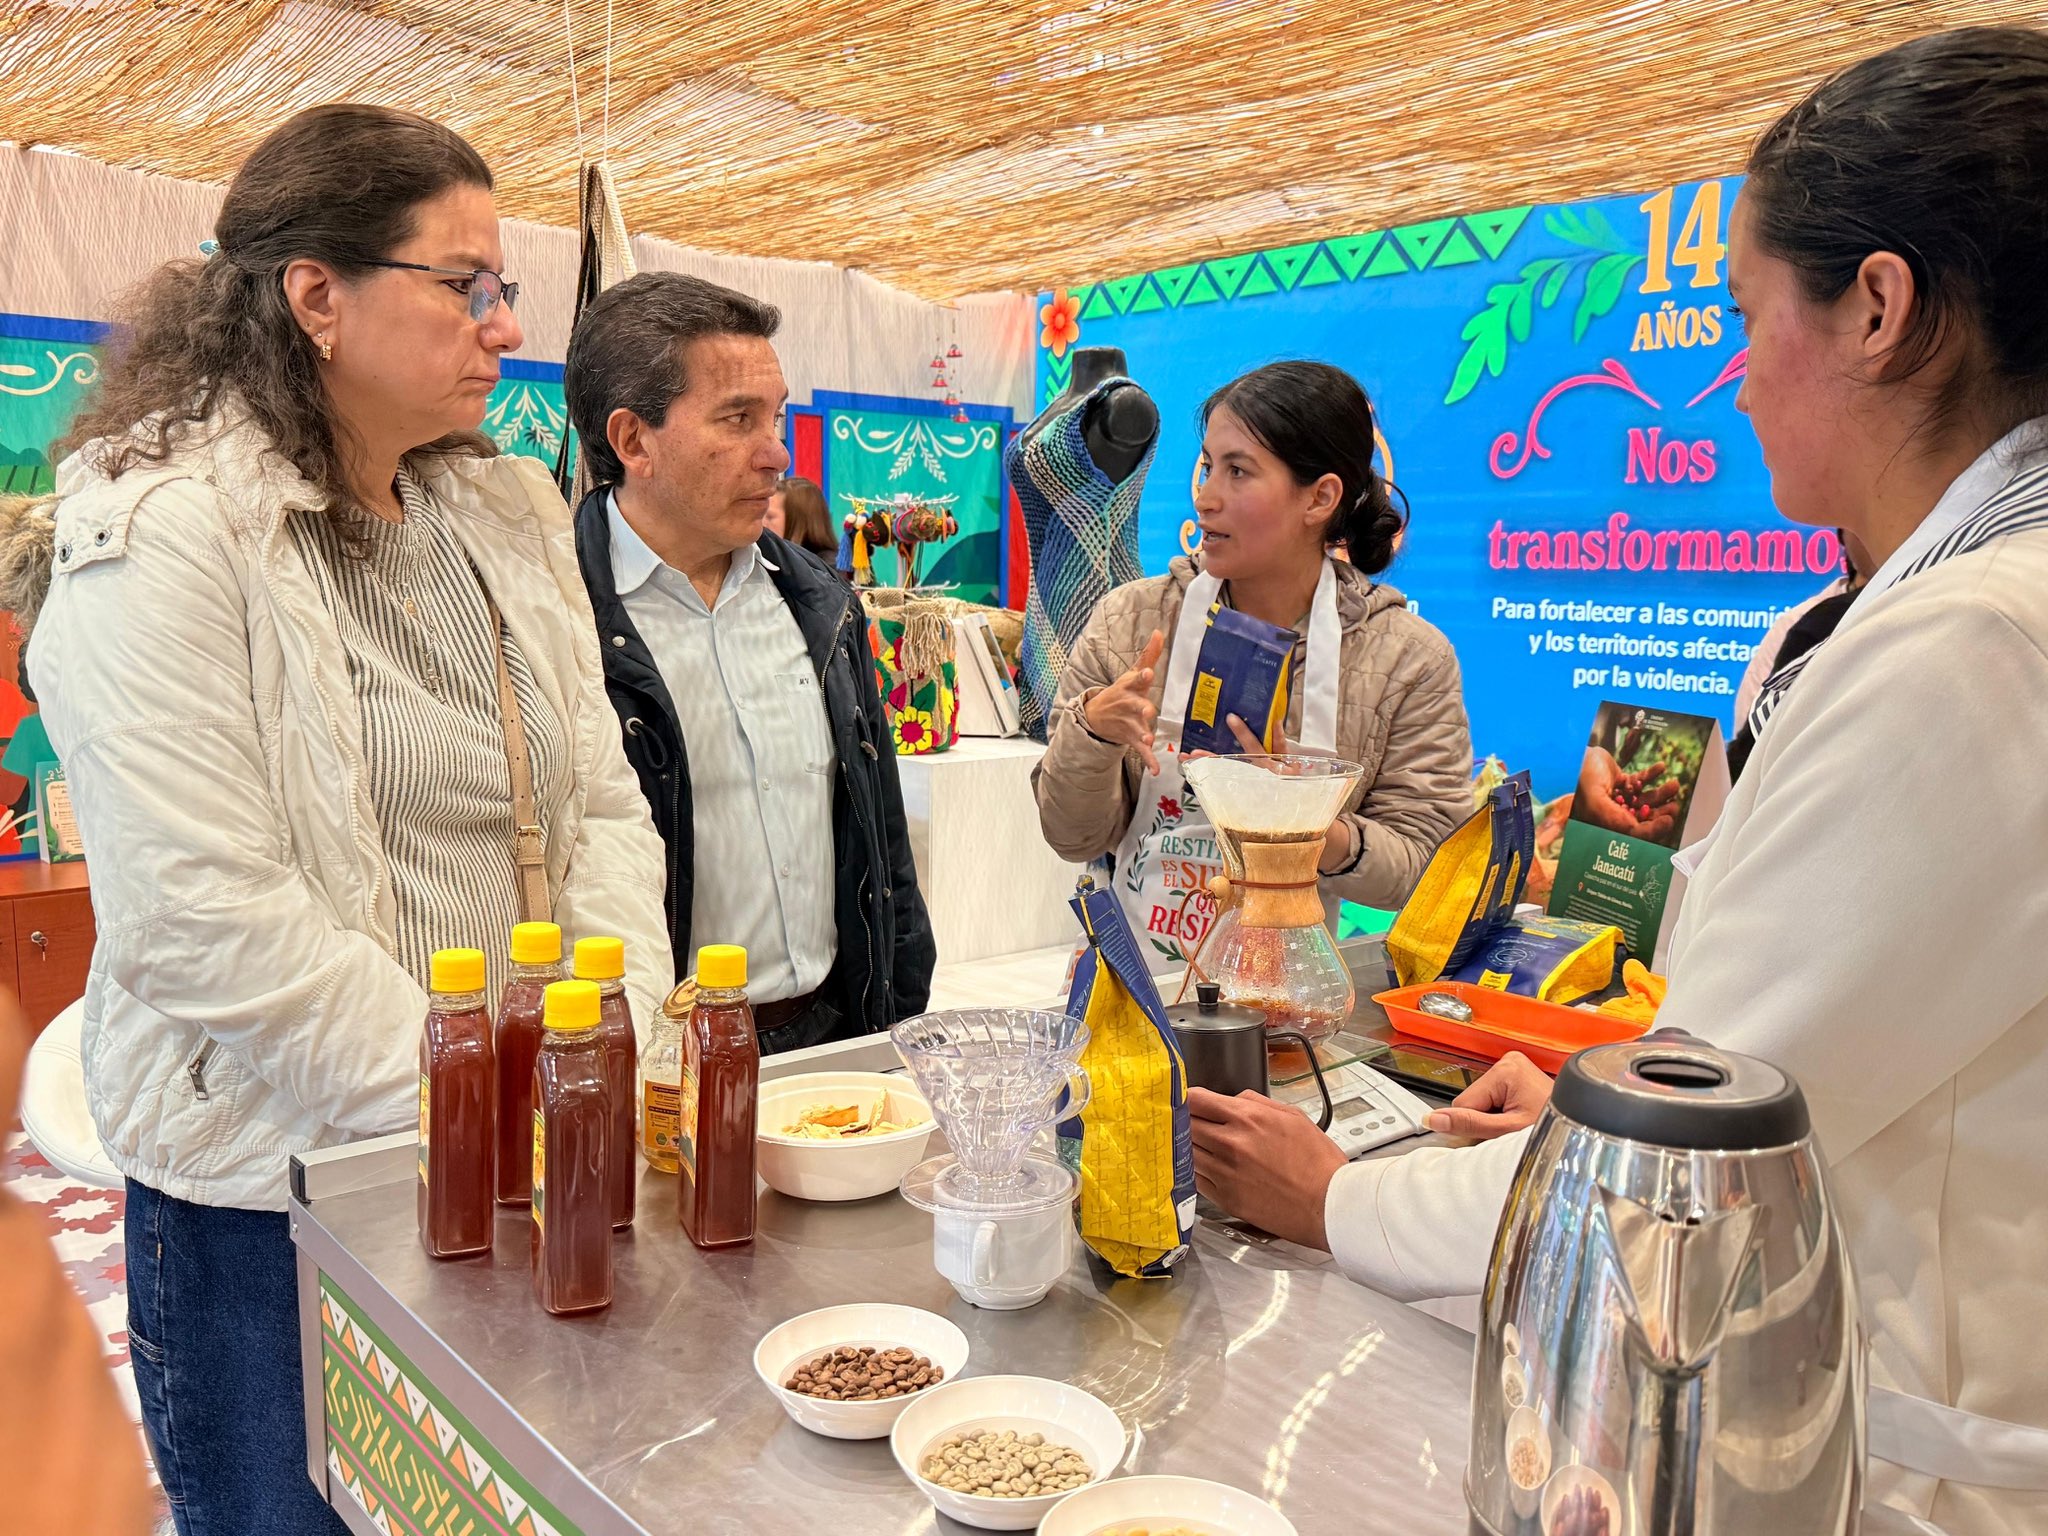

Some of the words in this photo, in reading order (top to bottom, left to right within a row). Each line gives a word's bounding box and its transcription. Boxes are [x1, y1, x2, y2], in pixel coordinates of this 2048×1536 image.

[1639, 181, 1725, 294] 14
[1630, 301, 1722, 352] AÑOS
[1624, 427, 1716, 484] Nos
[1492, 597, 1536, 620] Para
[1538, 598, 1637, 624] fortalecer
[1638, 606, 1653, 624] a
[1656, 602, 1689, 626] las
[1528, 634, 1543, 655] y
[1545, 629, 1575, 652] los
[1577, 632, 1679, 658] territorios
[1573, 667, 1610, 689] por
[1612, 664, 1632, 688] la
[1635, 666, 1735, 695] violencia.
[1608, 839, 1630, 861] Café
[1161, 860, 1178, 872] ES
[1163, 873, 1179, 888] EL
[1181, 861, 1223, 890] SU
[1592, 855, 1635, 883] Janacatú
